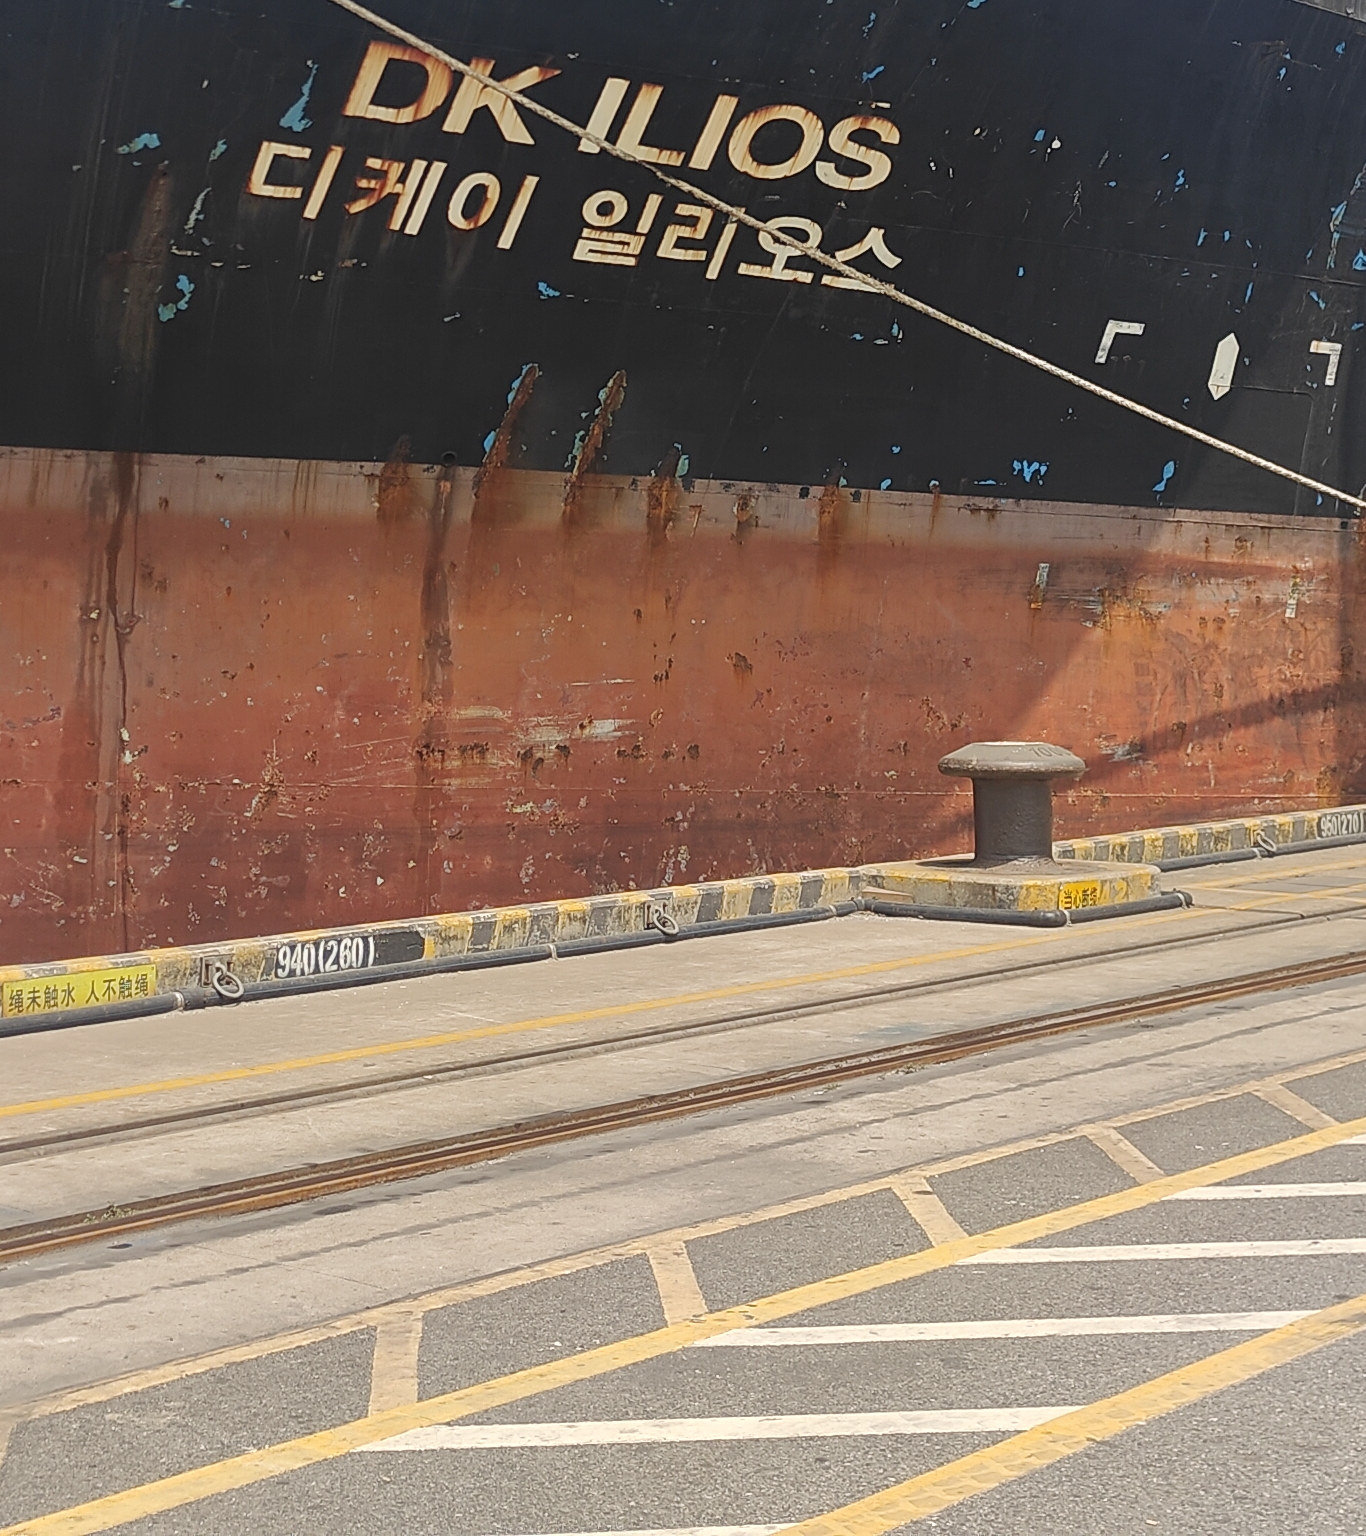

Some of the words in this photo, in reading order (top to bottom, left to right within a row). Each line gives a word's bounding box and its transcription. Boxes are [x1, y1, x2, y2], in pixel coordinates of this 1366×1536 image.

[341, 39, 563, 146] DK
[577, 76, 902, 192] ILIOS
[245, 140, 541, 251] 디케이
[571, 188, 904, 295] 일리오스
[8, 983, 77, 1014] 绳未触水
[85, 972, 150, 1005] 人不触绳
[277, 935, 376, 978] 940(260)
